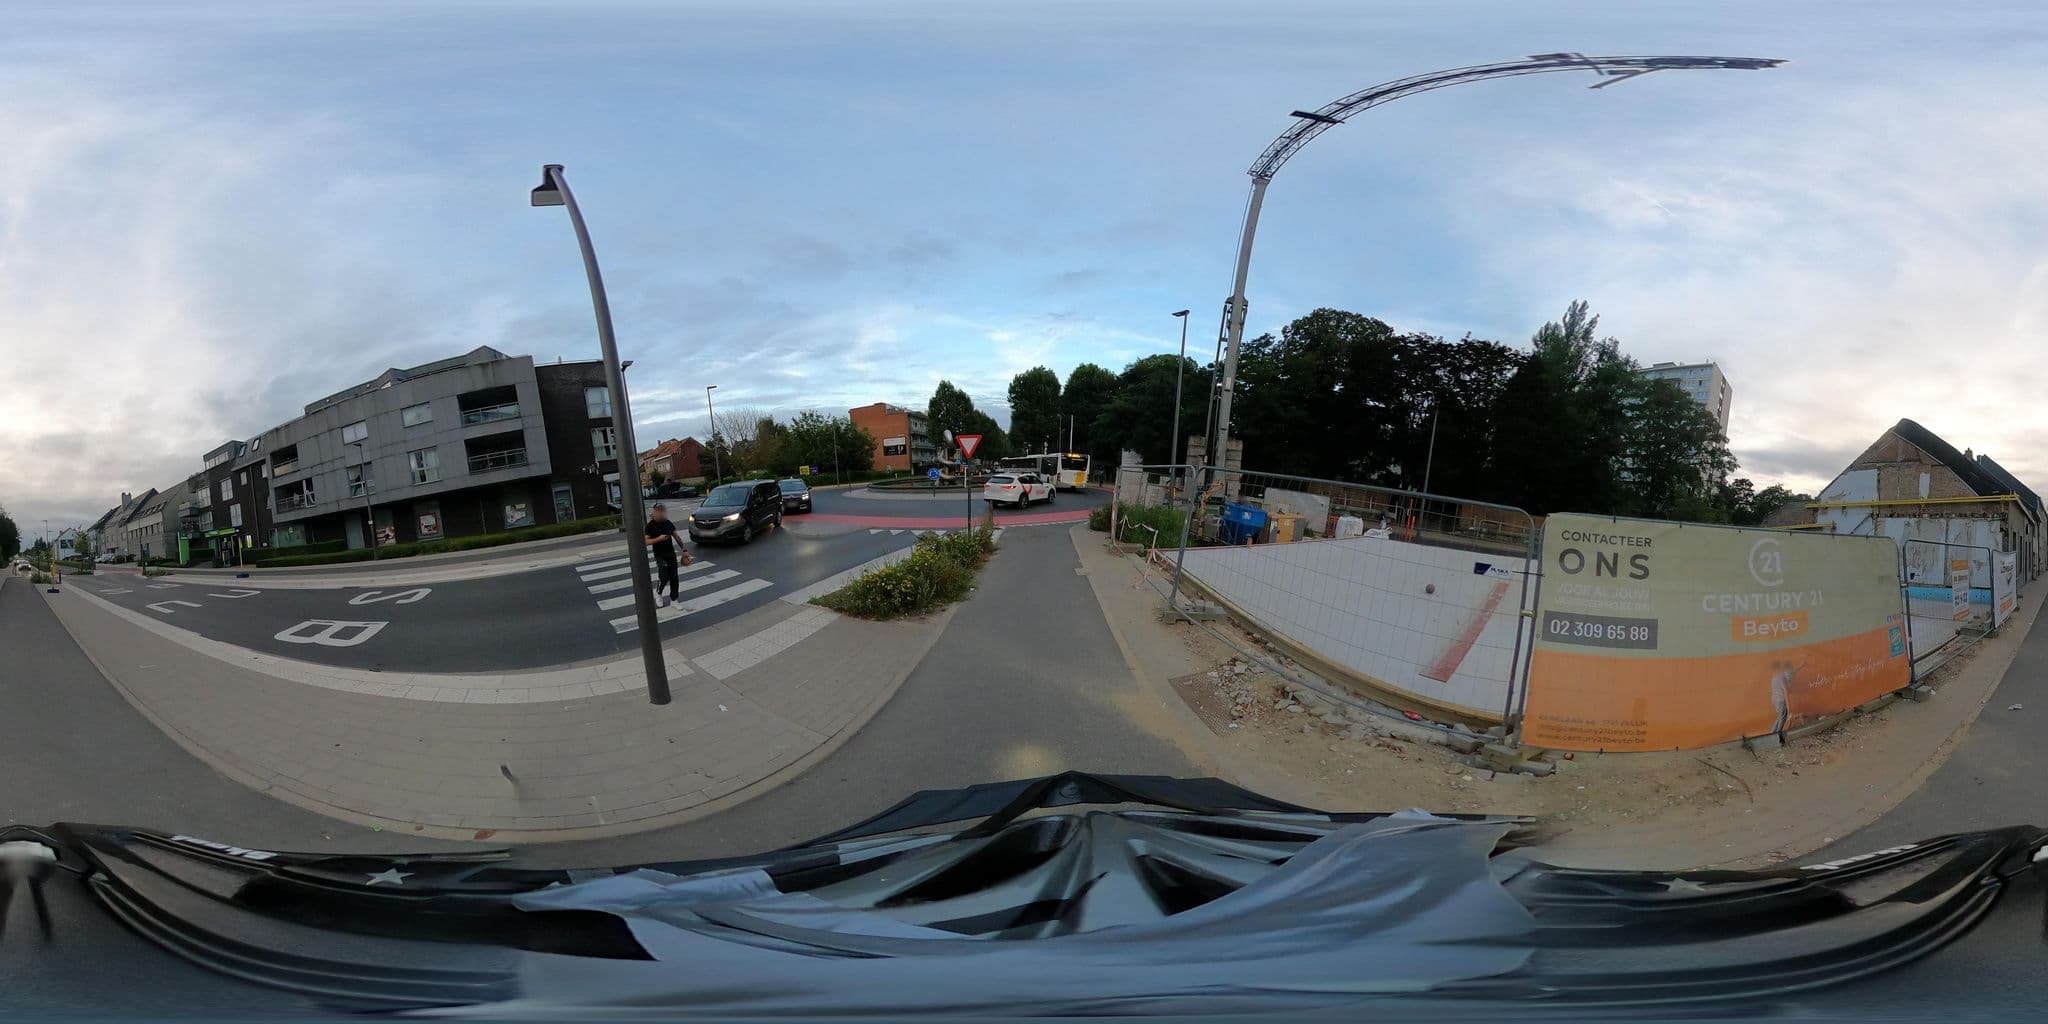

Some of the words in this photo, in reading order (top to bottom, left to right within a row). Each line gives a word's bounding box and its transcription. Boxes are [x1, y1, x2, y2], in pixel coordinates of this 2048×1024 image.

[1561, 530, 1653, 547] CONTACTEER
[1558, 548, 1650, 580] ONS
[1702, 591, 1804, 613] CENTURY
[1550, 619, 1570, 636] 02
[1574, 621, 1603, 639] 309
[1607, 624, 1626, 640] 65
[1630, 626, 1649, 641] 88
[1743, 618, 1798, 637] Beyto
